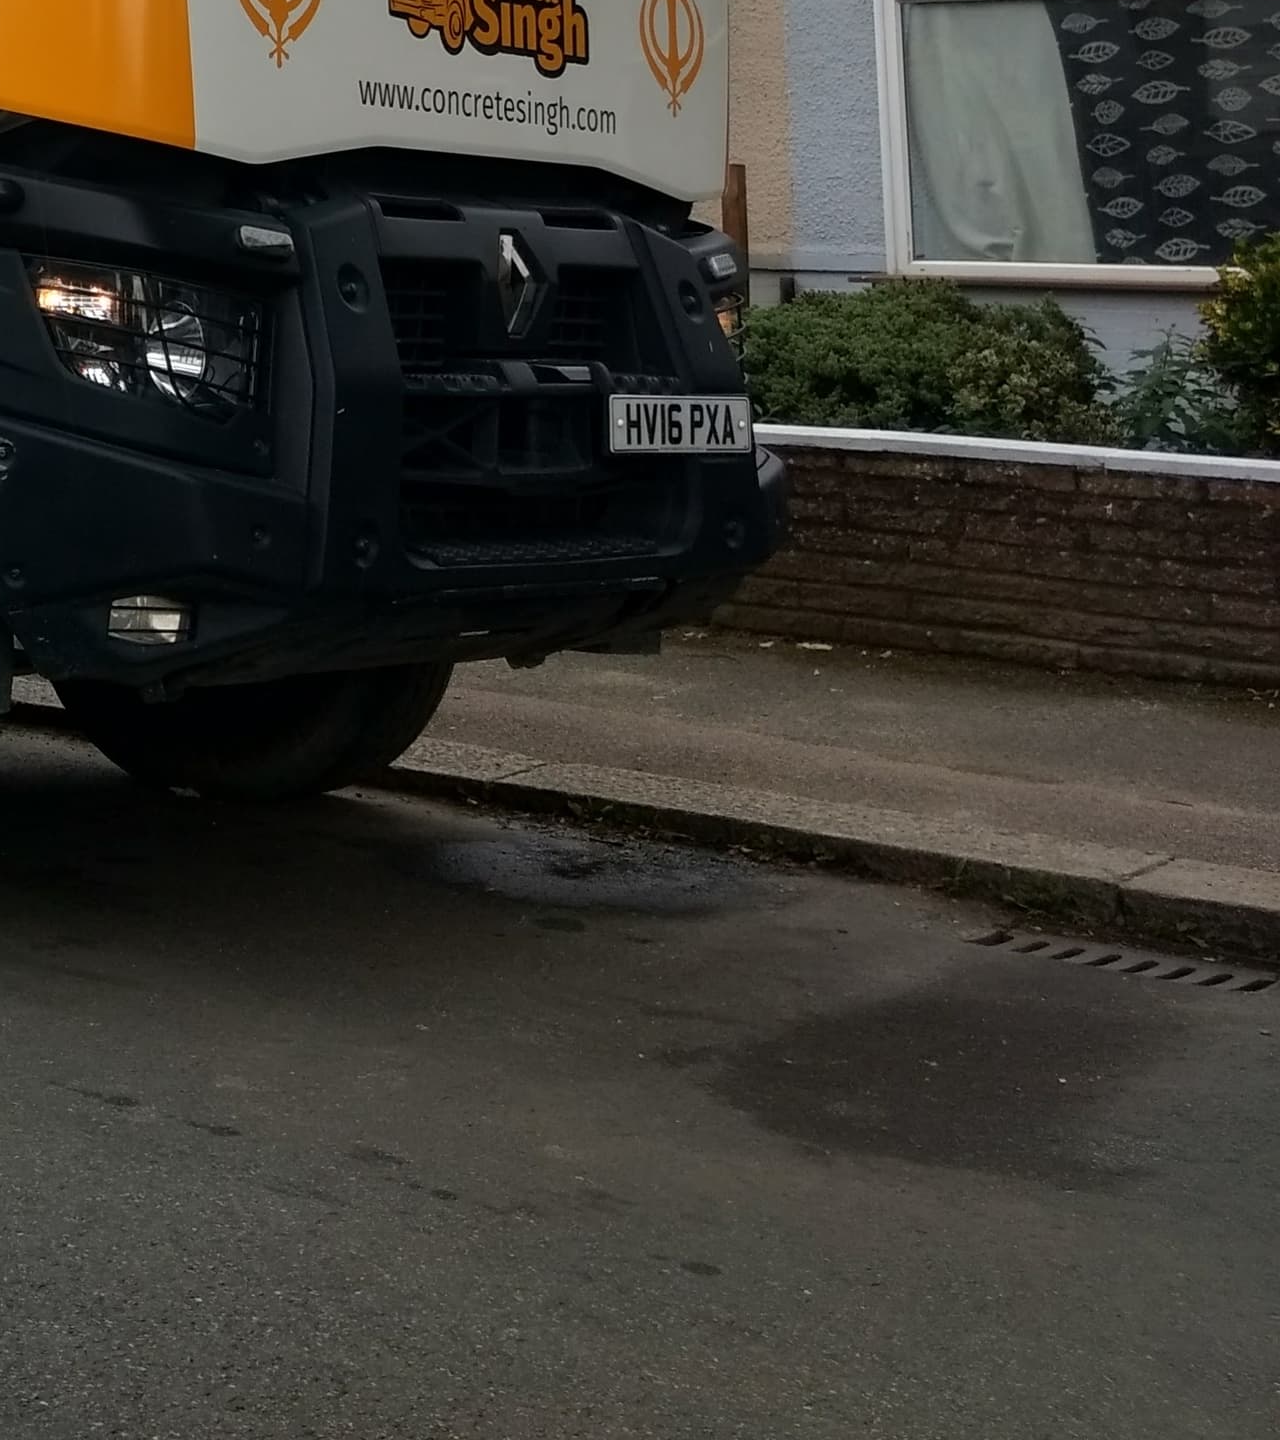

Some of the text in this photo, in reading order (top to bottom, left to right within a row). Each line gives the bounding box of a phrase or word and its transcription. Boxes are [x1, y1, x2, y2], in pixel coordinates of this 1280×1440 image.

[358, 80, 617, 135] www.concretesingh.com
[625, 403, 736, 446] HV16 PXA
